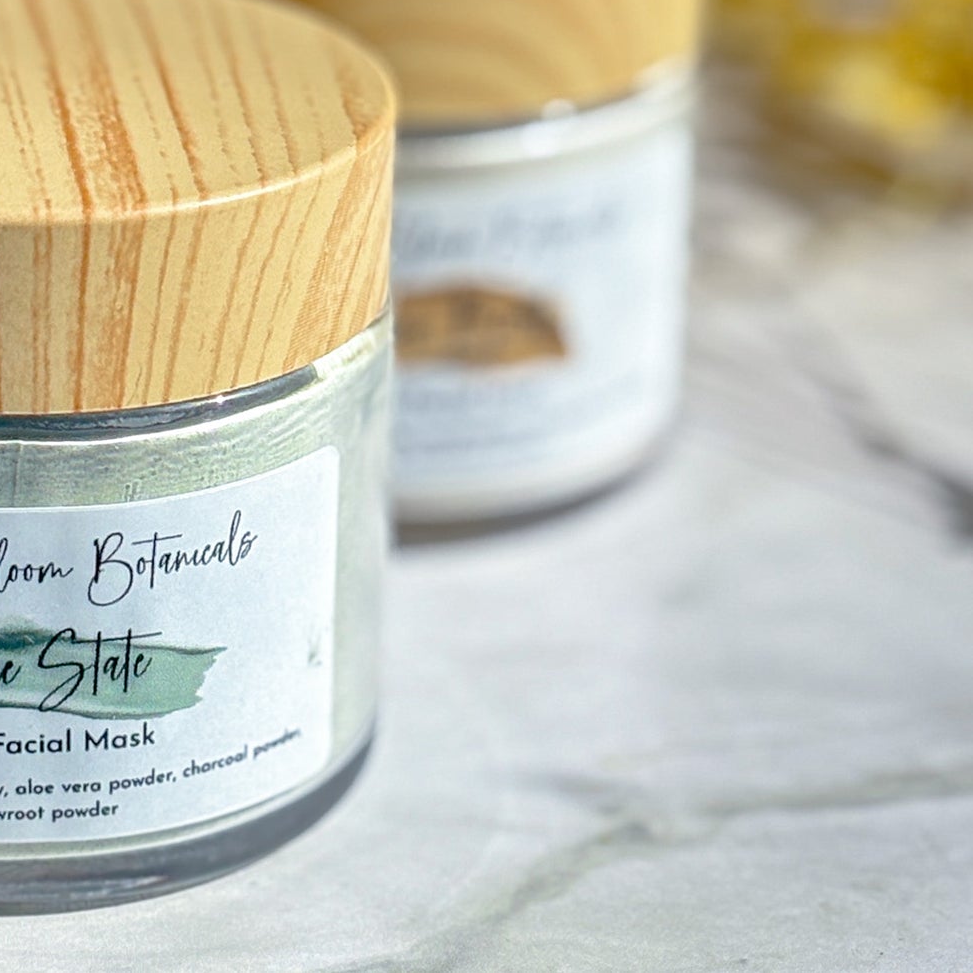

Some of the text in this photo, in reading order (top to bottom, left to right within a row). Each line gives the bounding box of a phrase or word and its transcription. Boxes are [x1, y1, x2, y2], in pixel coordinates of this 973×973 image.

[87, 509, 258, 607] Botanicals
[37, 627, 163, 712] State
[84, 722, 156, 752] Mask
[15, 778, 55, 797] aloe
[61, 780, 102, 795] vera
[108, 768, 177, 795] powder,
[182, 743, 249, 779] charcoal
[52, 800, 119, 823] powder
